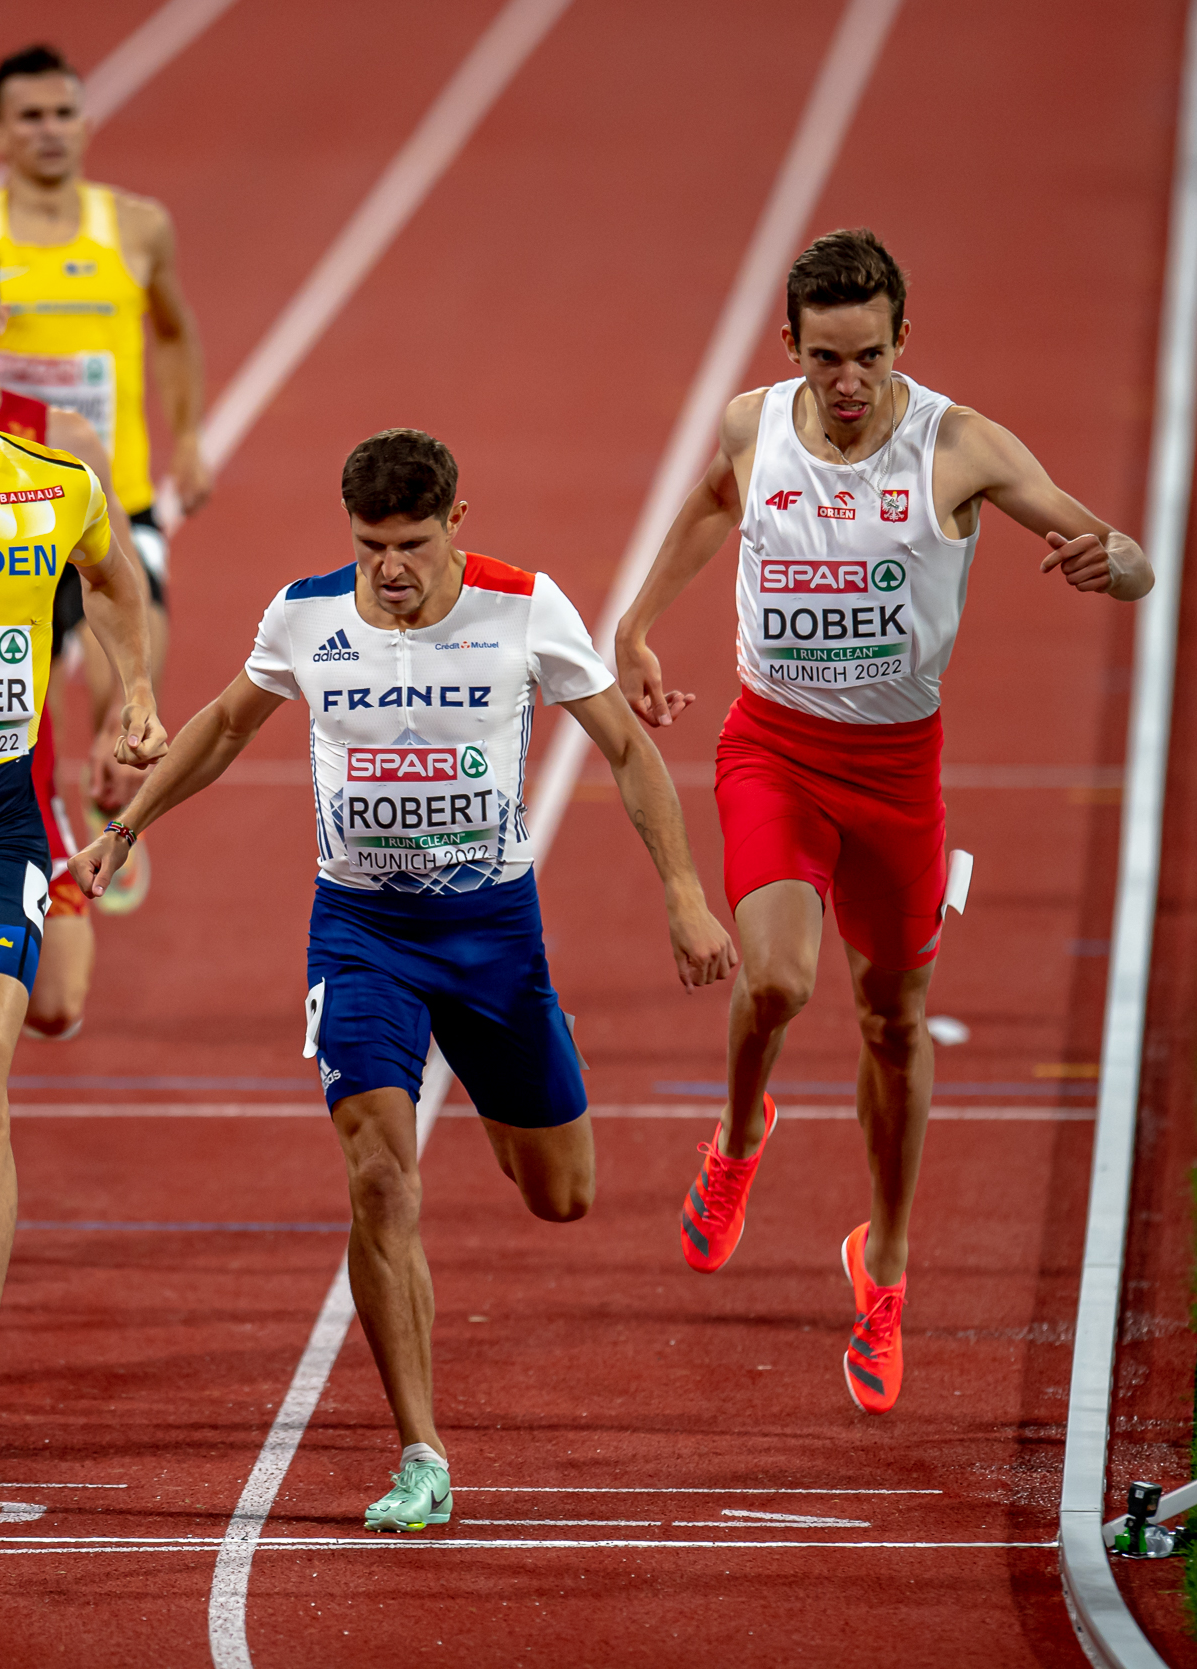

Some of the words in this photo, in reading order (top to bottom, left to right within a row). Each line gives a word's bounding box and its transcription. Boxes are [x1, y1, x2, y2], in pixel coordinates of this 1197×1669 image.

[0, 485, 63, 504] BAUHAUS
[765, 490, 803, 510] 4F
[819, 507, 854, 518] ORLEN
[763, 564, 865, 589] SPAR
[763, 604, 908, 641] DOBEK
[470, 640, 499, 649] Mutuel
[313, 649, 360, 663] adidas
[793, 649, 797, 659] I
[800, 649, 827, 660] RUN
[769, 664, 847, 683] MUNICH
[855, 658, 902, 680] 2022
[323, 685, 492, 712] FRANCE
[350, 753, 454, 777] SPAR
[349, 789, 493, 830] ROBERT
[382, 837, 385, 846] I
[389, 837, 415, 848] RUN
[358, 851, 436, 870] MUNICH
